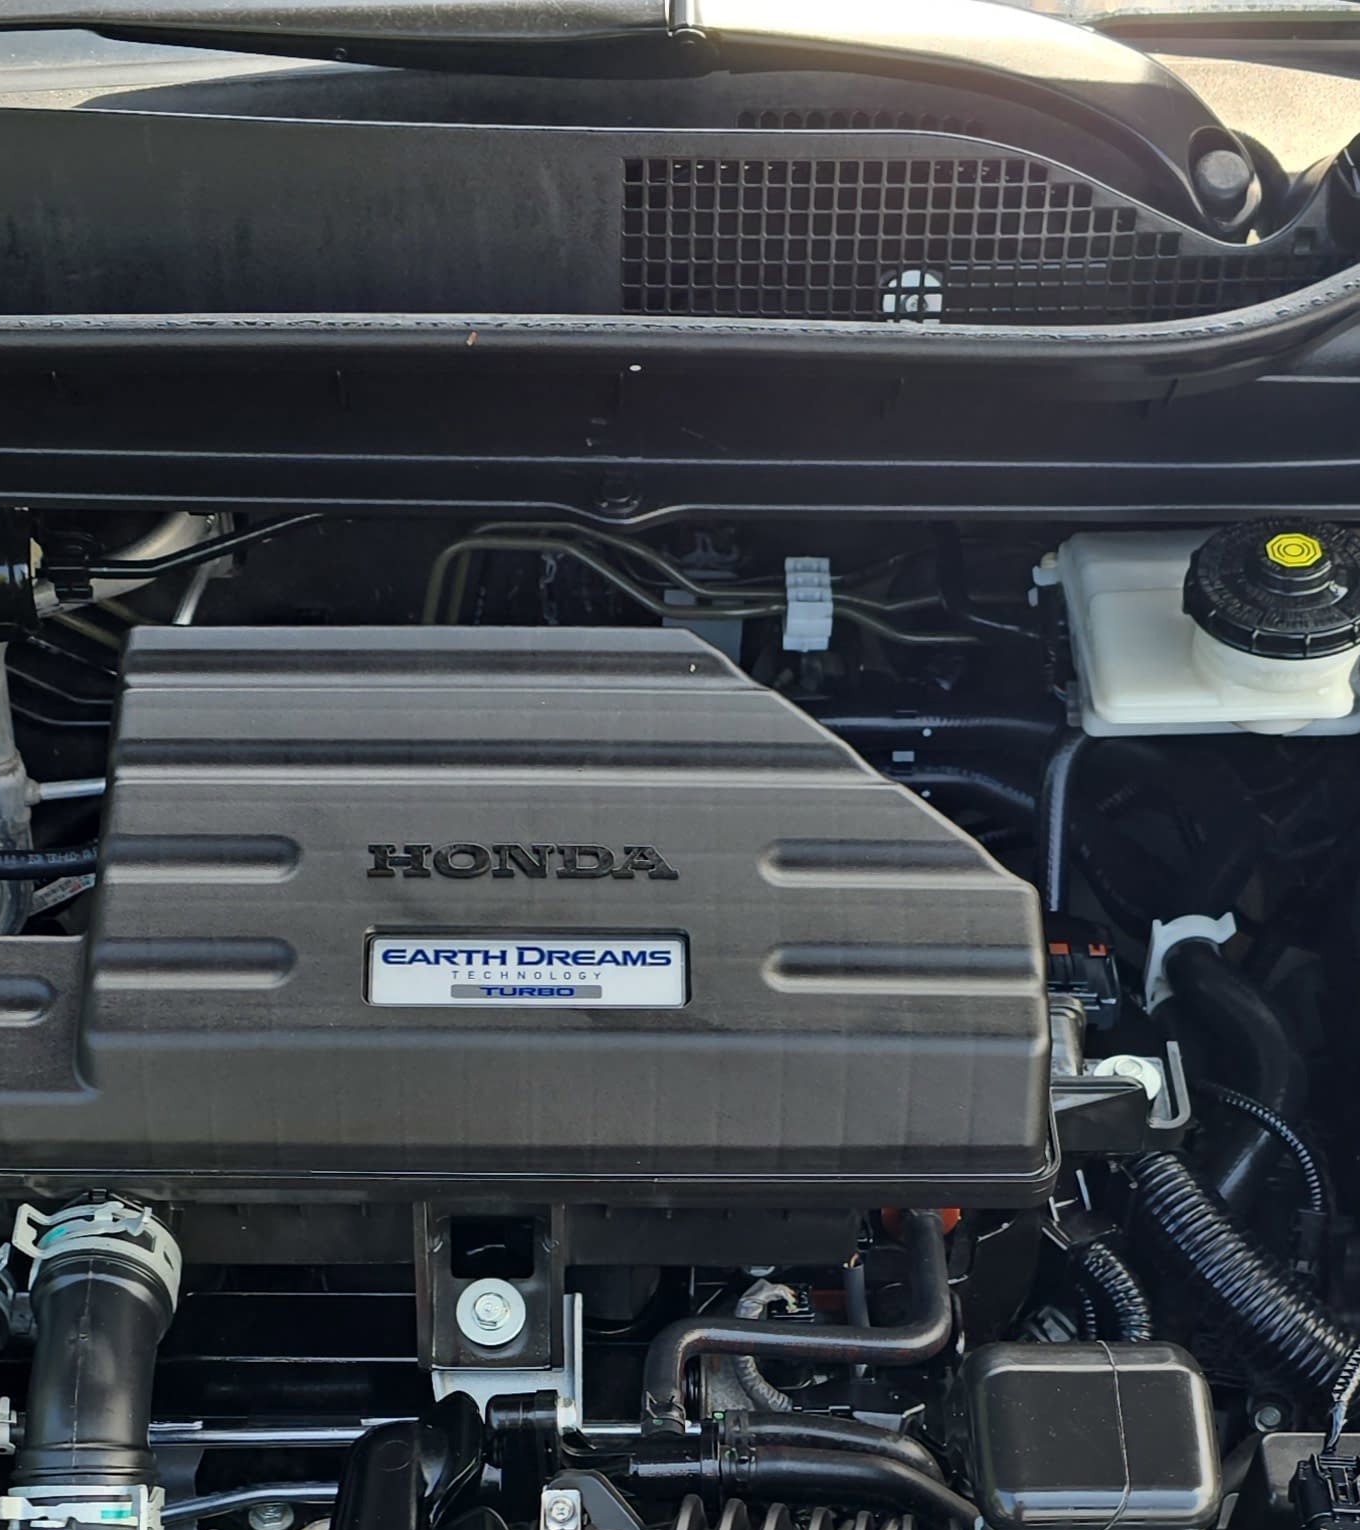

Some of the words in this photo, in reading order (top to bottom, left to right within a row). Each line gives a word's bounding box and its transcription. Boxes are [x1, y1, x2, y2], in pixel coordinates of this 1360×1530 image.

[367, 842, 680, 880] HONDA
[382, 948, 507, 966] EARTH
[515, 946, 672, 967] DREAMS
[451, 970, 602, 981] TECHNOLOGY
[480, 986, 575, 997] TURBO
